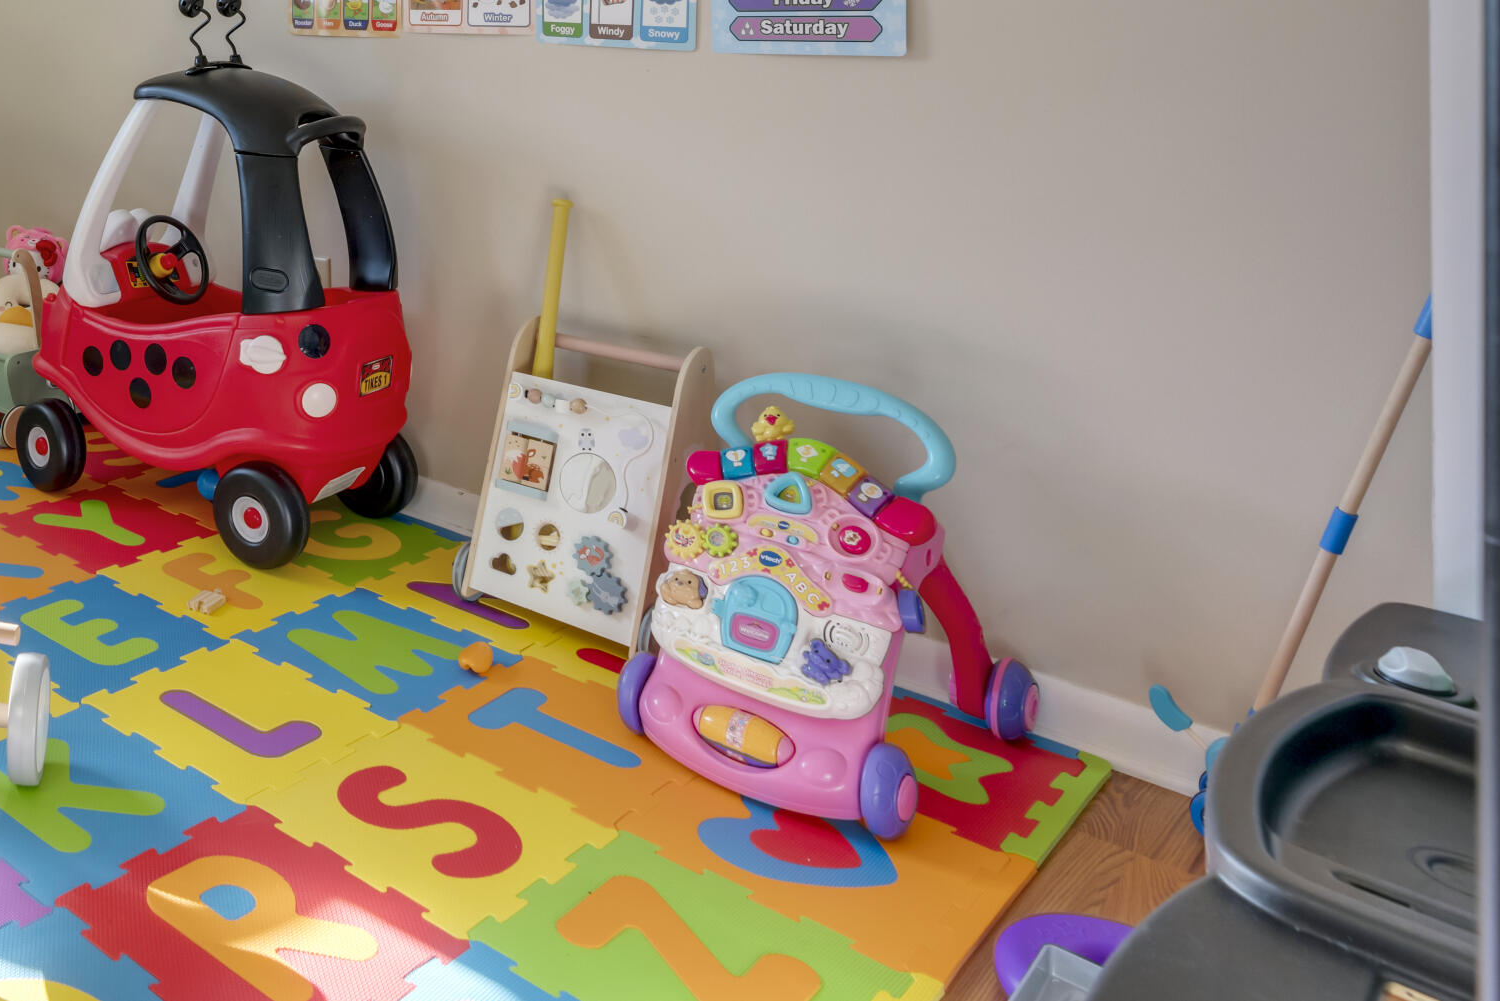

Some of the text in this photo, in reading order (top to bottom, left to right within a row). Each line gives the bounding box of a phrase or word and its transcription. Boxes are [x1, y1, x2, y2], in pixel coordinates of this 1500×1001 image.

[421, 13, 448, 22] Autumn
[484, 13, 512, 23] Winter
[551, 25, 575, 35] Foggy
[598, 27, 625, 37] Windy
[760, 20, 848, 37] Saturday
[648, 29, 680, 39] Snowy
[365, 374, 387, 392] TIKES 1
[760, 554, 782, 564] vtech
